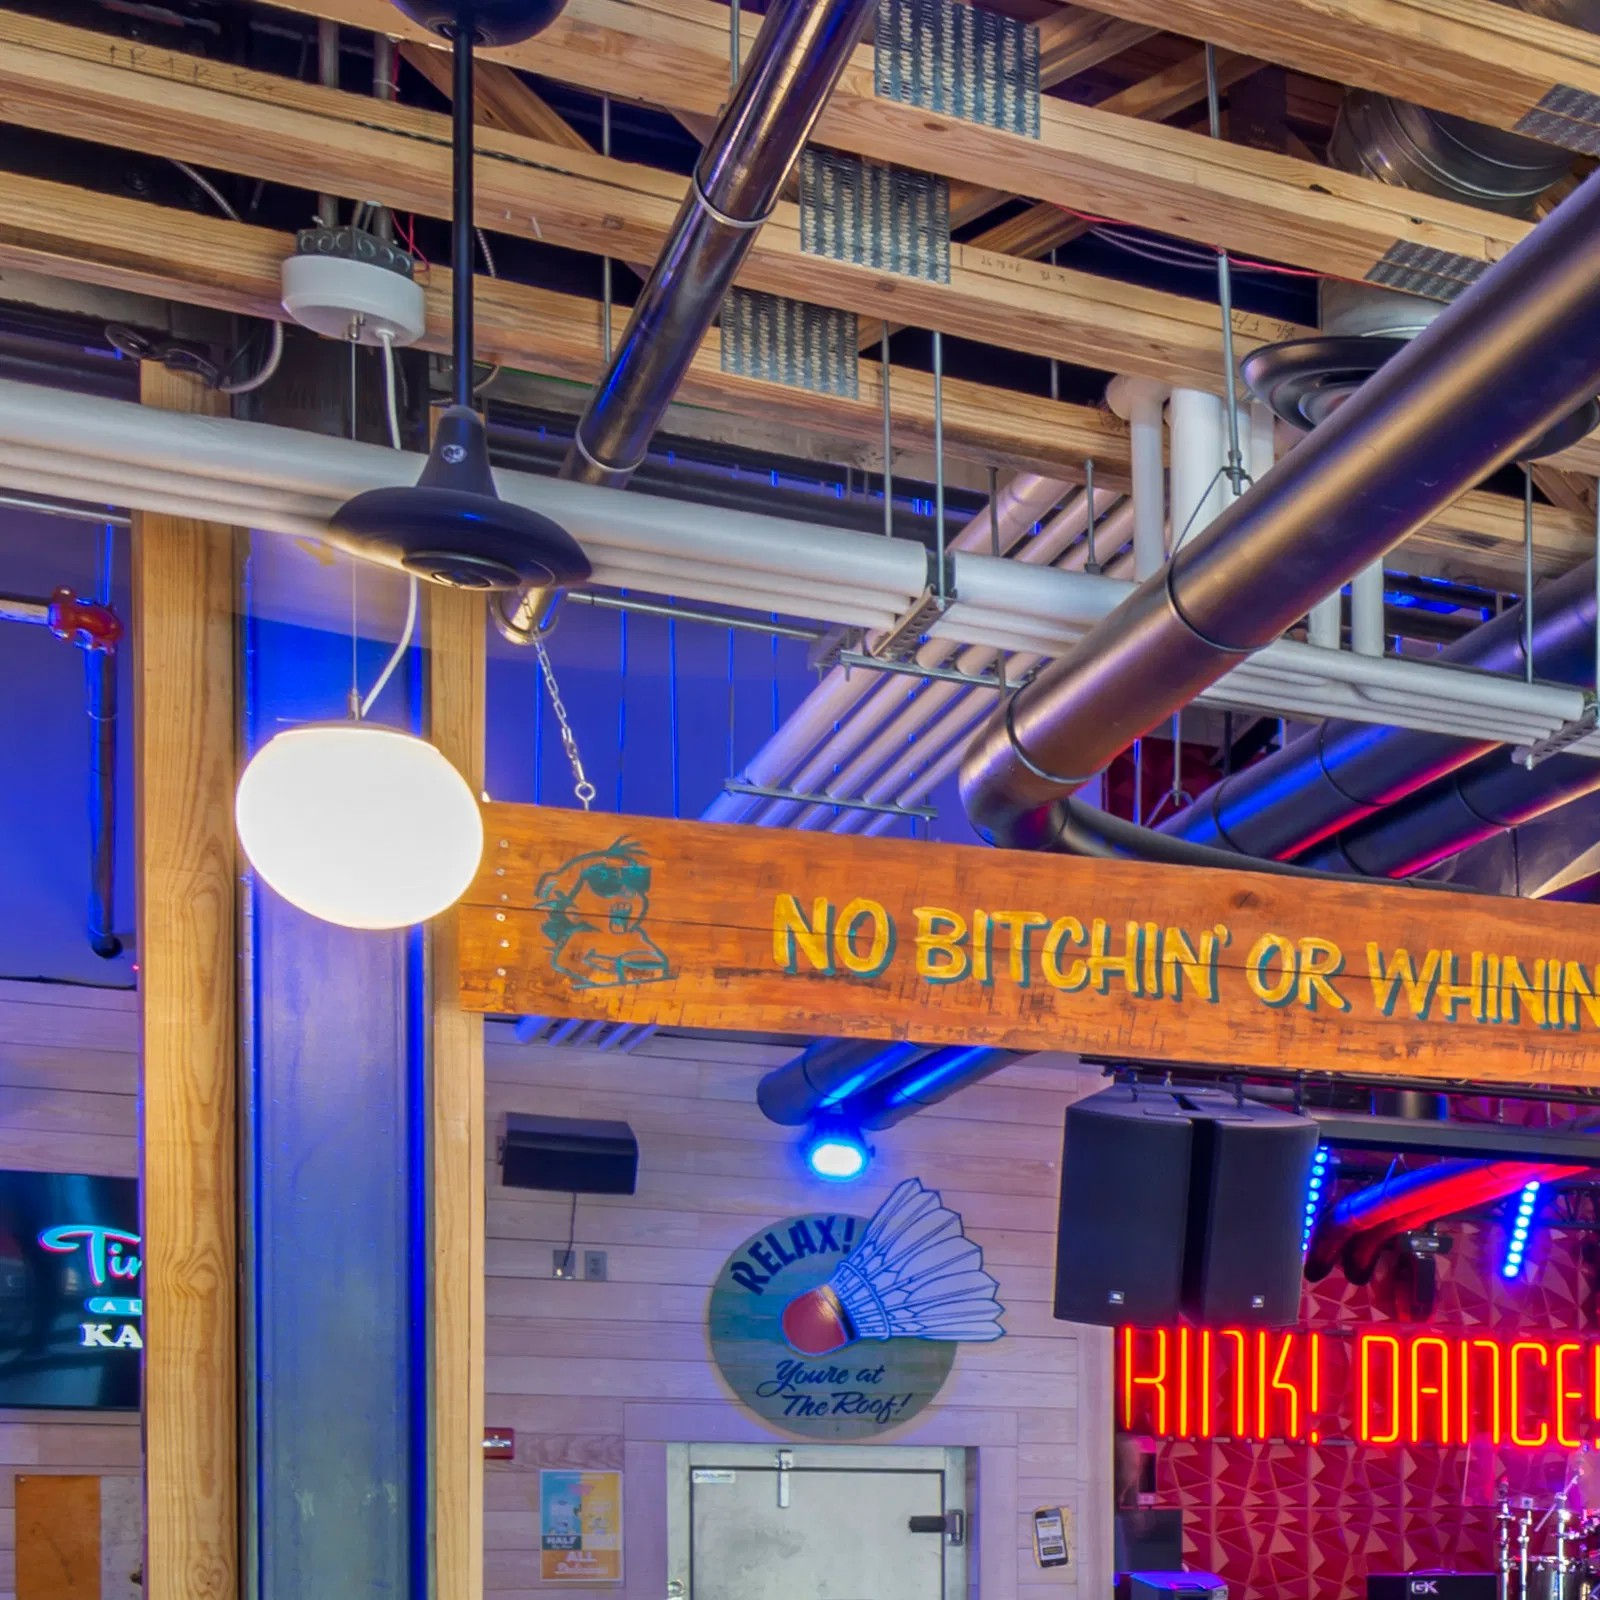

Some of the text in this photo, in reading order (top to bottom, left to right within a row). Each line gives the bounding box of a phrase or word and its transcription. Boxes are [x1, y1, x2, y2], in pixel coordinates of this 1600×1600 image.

[773, 893, 896, 979] NO
[912, 906, 1231, 1003] BITCHIN'
[1246, 932, 1354, 1012] OR
[730, 1215, 855, 1296] RELAX!
[855, 1364, 885, 1384] at
[781, 1391, 913, 1424] The Roof!
[1411, 1580, 1439, 1595] GK
